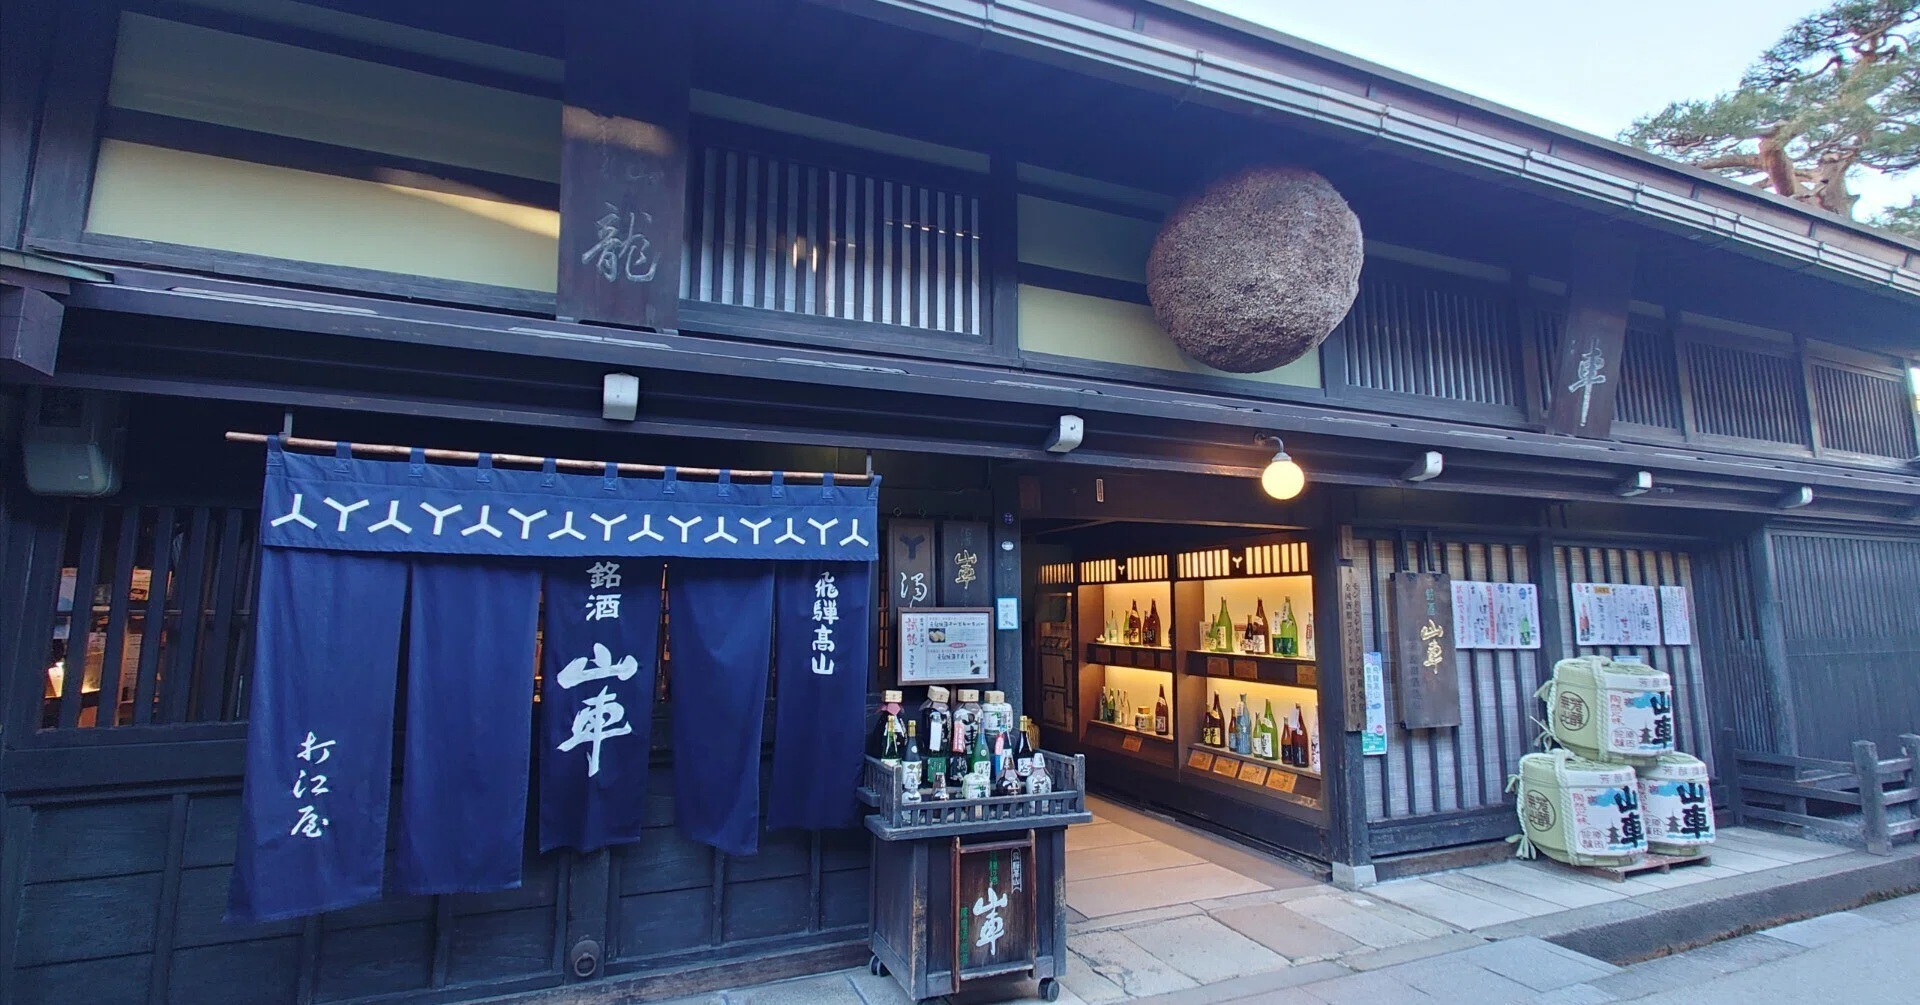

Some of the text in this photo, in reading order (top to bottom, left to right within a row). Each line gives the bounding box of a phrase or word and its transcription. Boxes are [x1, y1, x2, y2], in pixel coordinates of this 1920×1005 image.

[585, 561, 623, 622] 銘酒
[954, 549, 978, 590] 山車
[1419, 618, 1444, 675] 山車
[555, 642, 638, 778] 山車
[1650, 691, 1673, 749] 山車
[289, 730, 337, 838] 打江屋
[1676, 782, 1709, 839] 山車
[1613, 785, 1644, 848] 山車
[972, 886, 1008, 956] 山車
